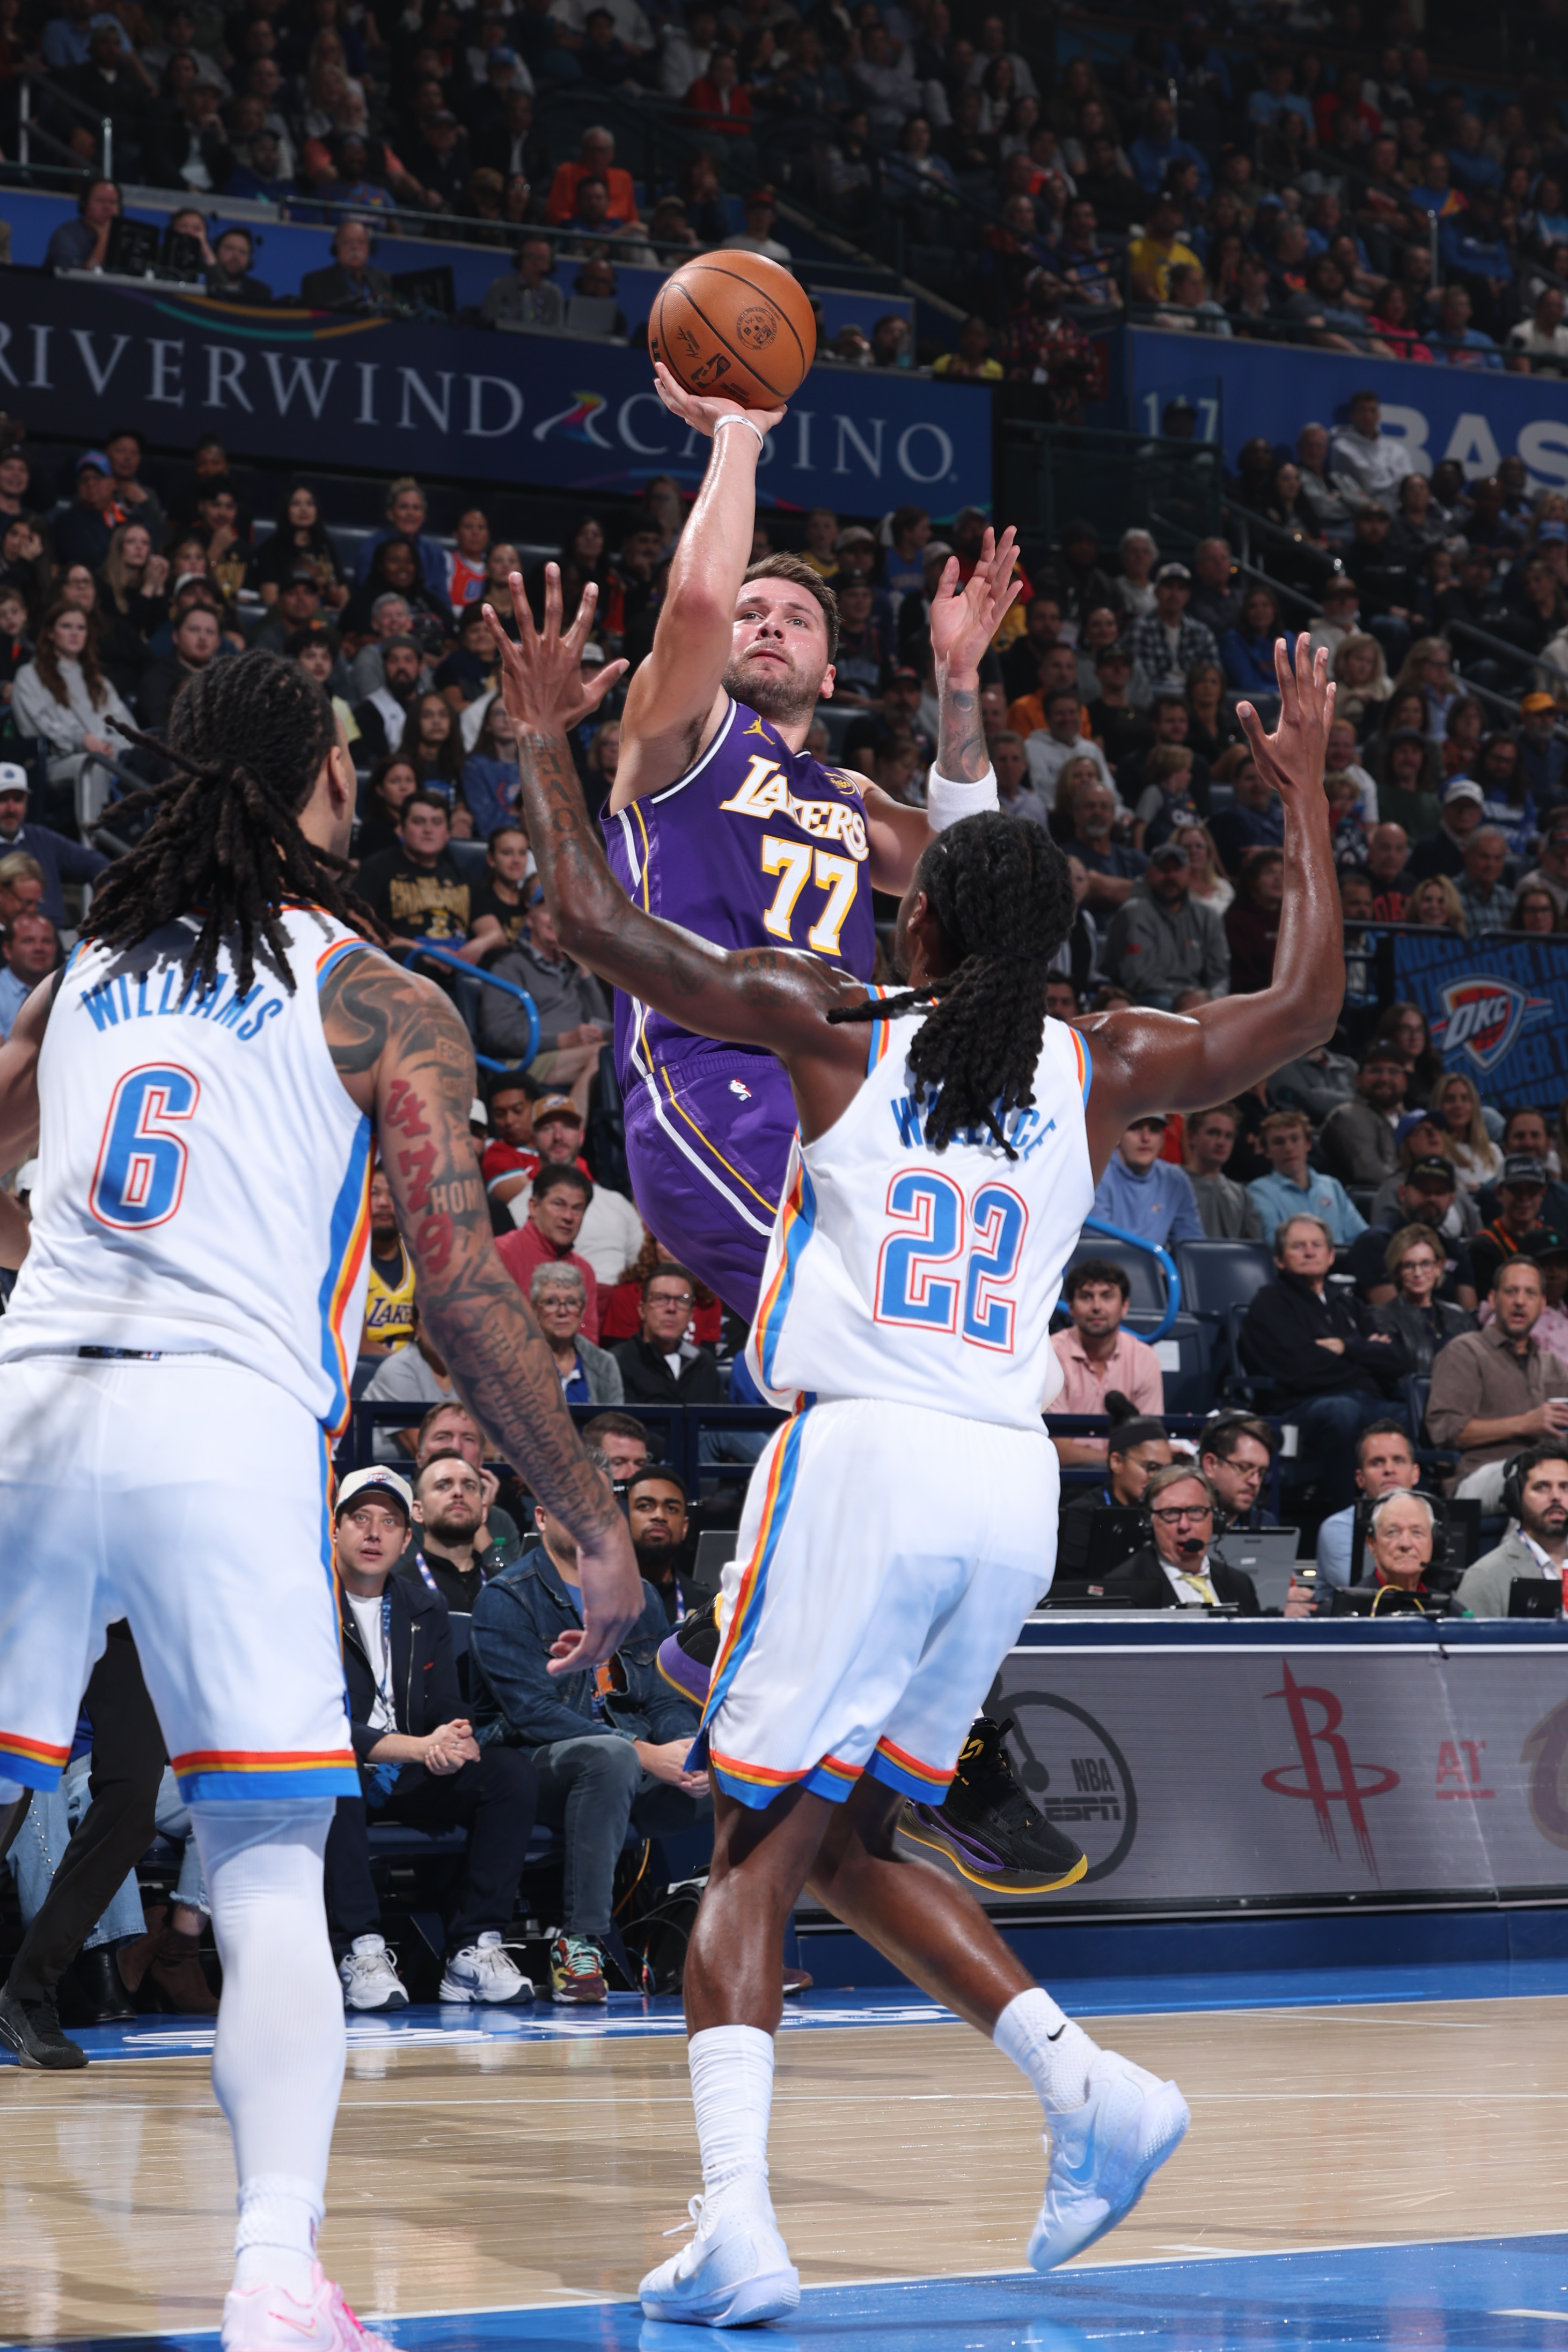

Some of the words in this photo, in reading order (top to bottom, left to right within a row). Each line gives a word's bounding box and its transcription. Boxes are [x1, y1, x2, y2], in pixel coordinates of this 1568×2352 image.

[0, 324, 525, 439] RIVERWIND
[617, 392, 954, 484] CINO
[1144, 392, 1219, 441] 17
[761, 834, 859, 957] 77
[1373, 891, 1411, 922] OK
[80, 969, 283, 1041] WILLIAMS
[1442, 993, 1510, 1051] OKC
[89, 1062, 201, 1230] 6
[873, 1168, 1029, 1354] 22
[1070, 1758, 1116, 1792] NBA
[1436, 1740, 1486, 1784] AT
[1044, 1796, 1122, 1822] ESPN
